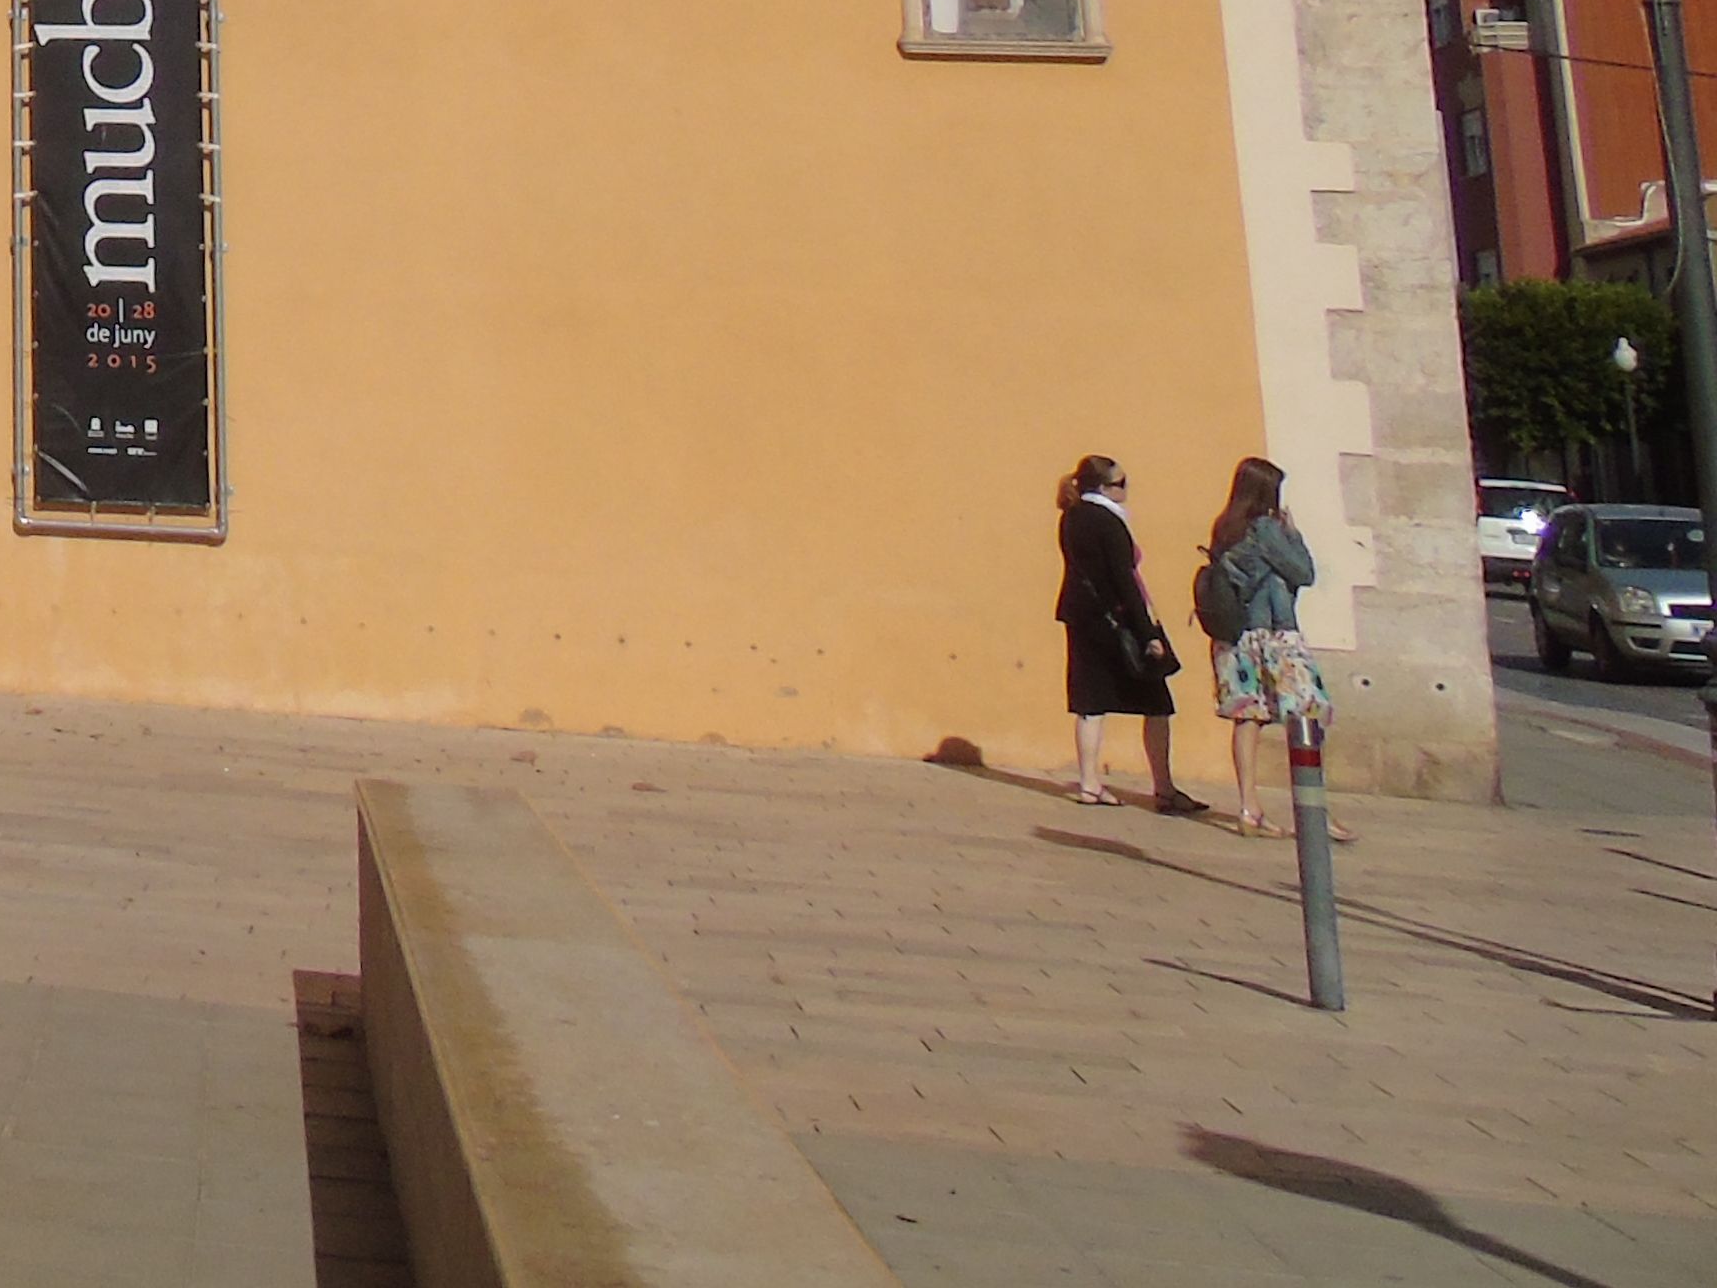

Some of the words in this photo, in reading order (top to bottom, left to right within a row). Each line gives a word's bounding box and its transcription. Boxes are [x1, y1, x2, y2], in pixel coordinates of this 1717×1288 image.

[86, 302, 112, 318] 20
[132, 300, 156, 319] 28
[86, 322, 110, 343] de
[112, 323, 156, 350] juny
